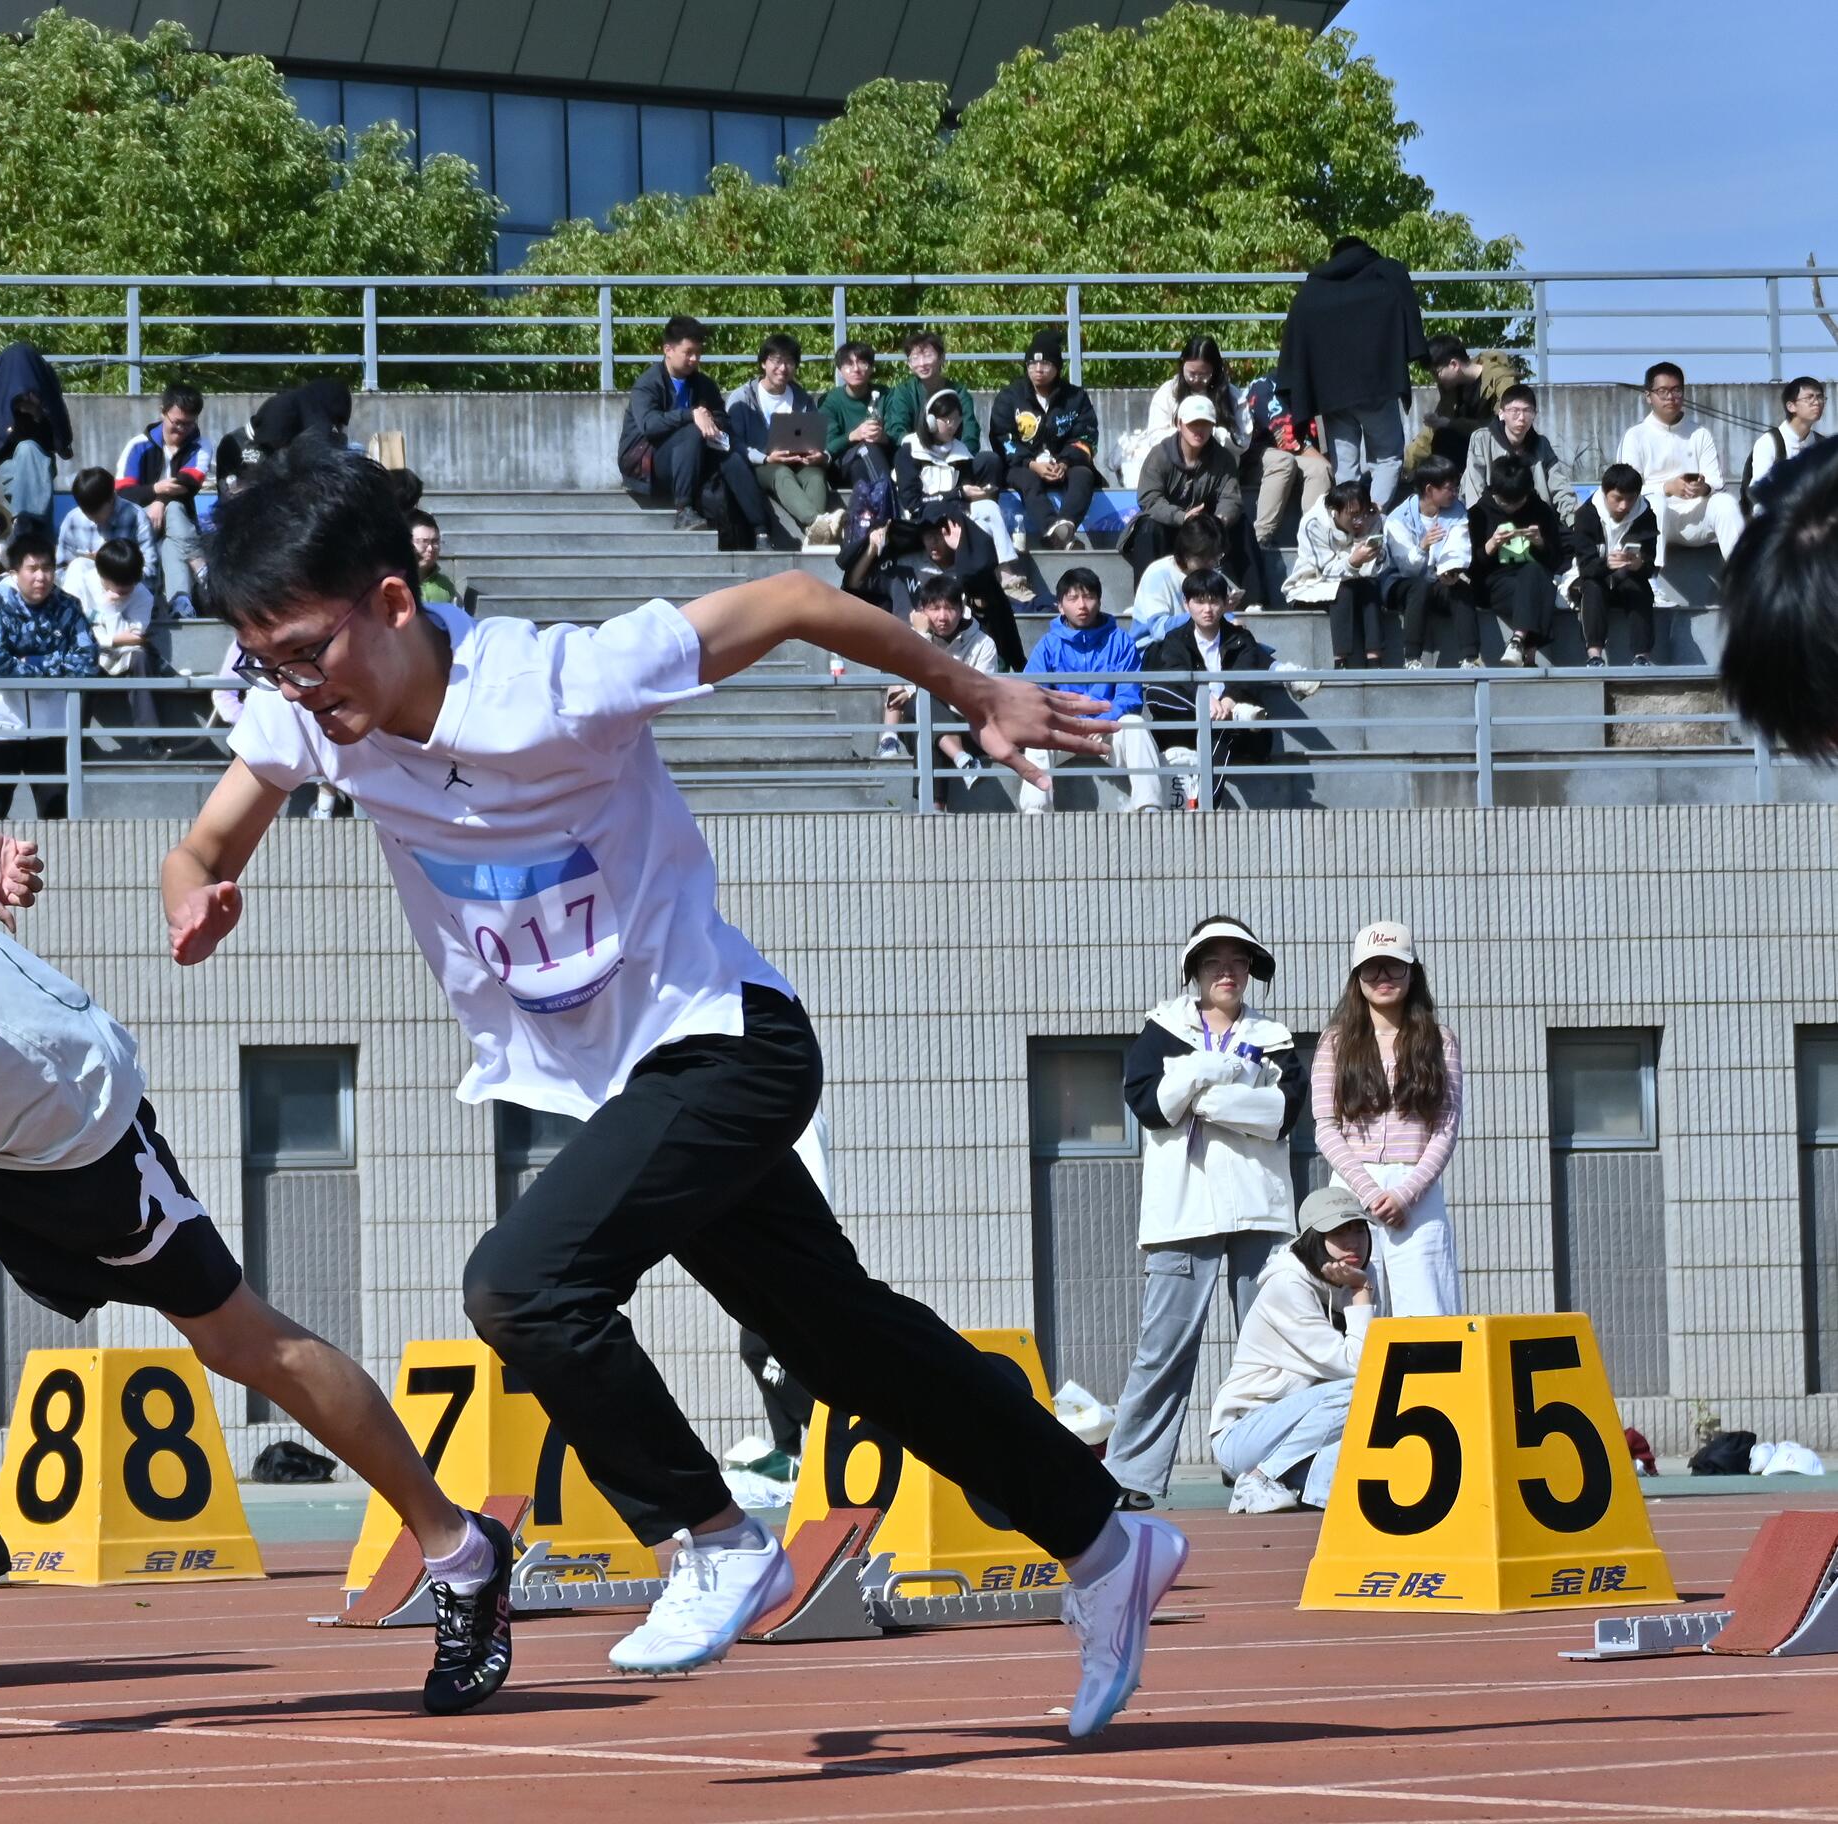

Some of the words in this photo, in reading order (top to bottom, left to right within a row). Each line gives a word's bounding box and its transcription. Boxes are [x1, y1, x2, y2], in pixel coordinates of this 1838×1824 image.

[16, 1368, 86, 1525] 8
[121, 1366, 212, 1522] 8
[406, 1365, 476, 1480] 7
[1357, 1341, 1463, 1536] 5
[1510, 1336, 1612, 1534] 5
[11, 1551, 65, 1572] 金陵
[144, 1550, 218, 1572] 金陵
[981, 1563, 1062, 1590] 金陵
[1357, 1571, 1449, 1599] 金陵
[1549, 1565, 1630, 1595] 金陵
